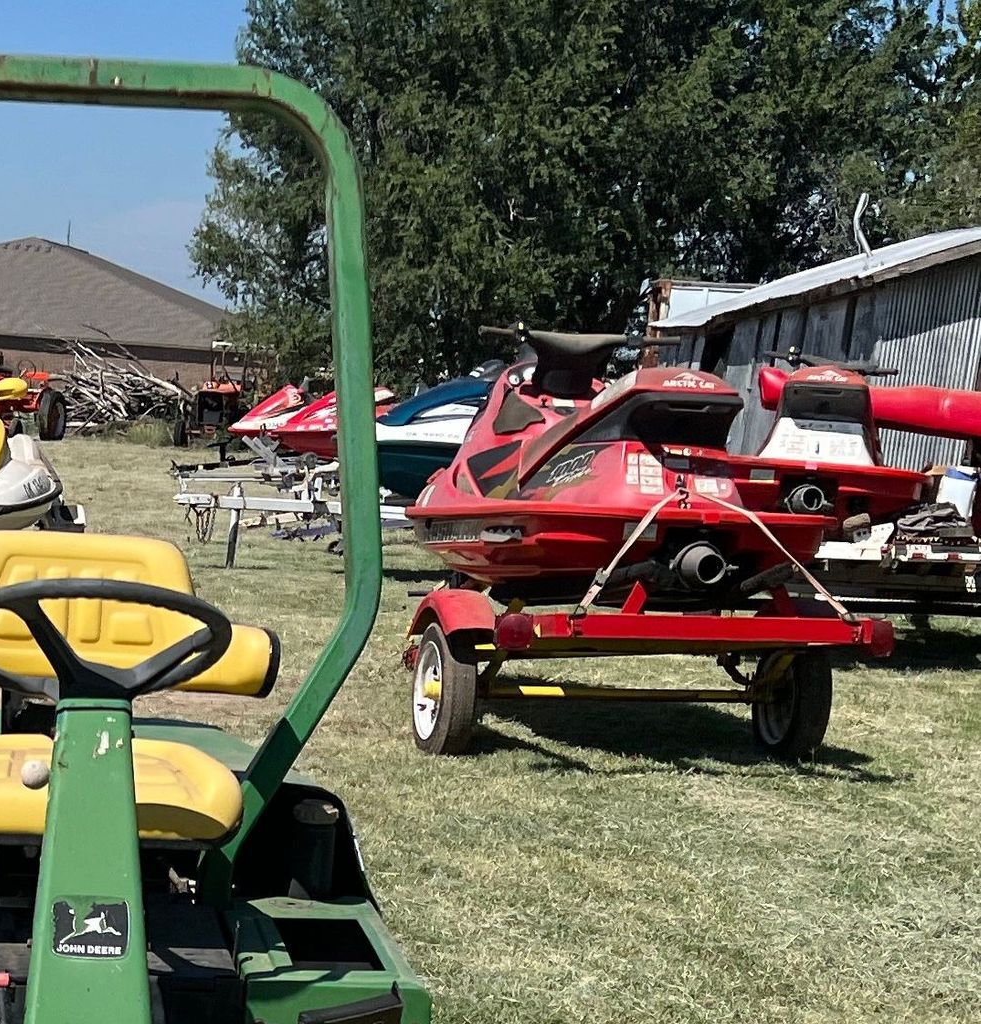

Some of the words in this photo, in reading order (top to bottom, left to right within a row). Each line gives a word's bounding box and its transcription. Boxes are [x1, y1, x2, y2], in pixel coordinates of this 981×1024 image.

[662, 379, 697, 388] ARCTIC
[699, 381, 715, 389] CAT
[56, 944, 86, 954] JOHN
[87, 945, 122, 955] DEERE
